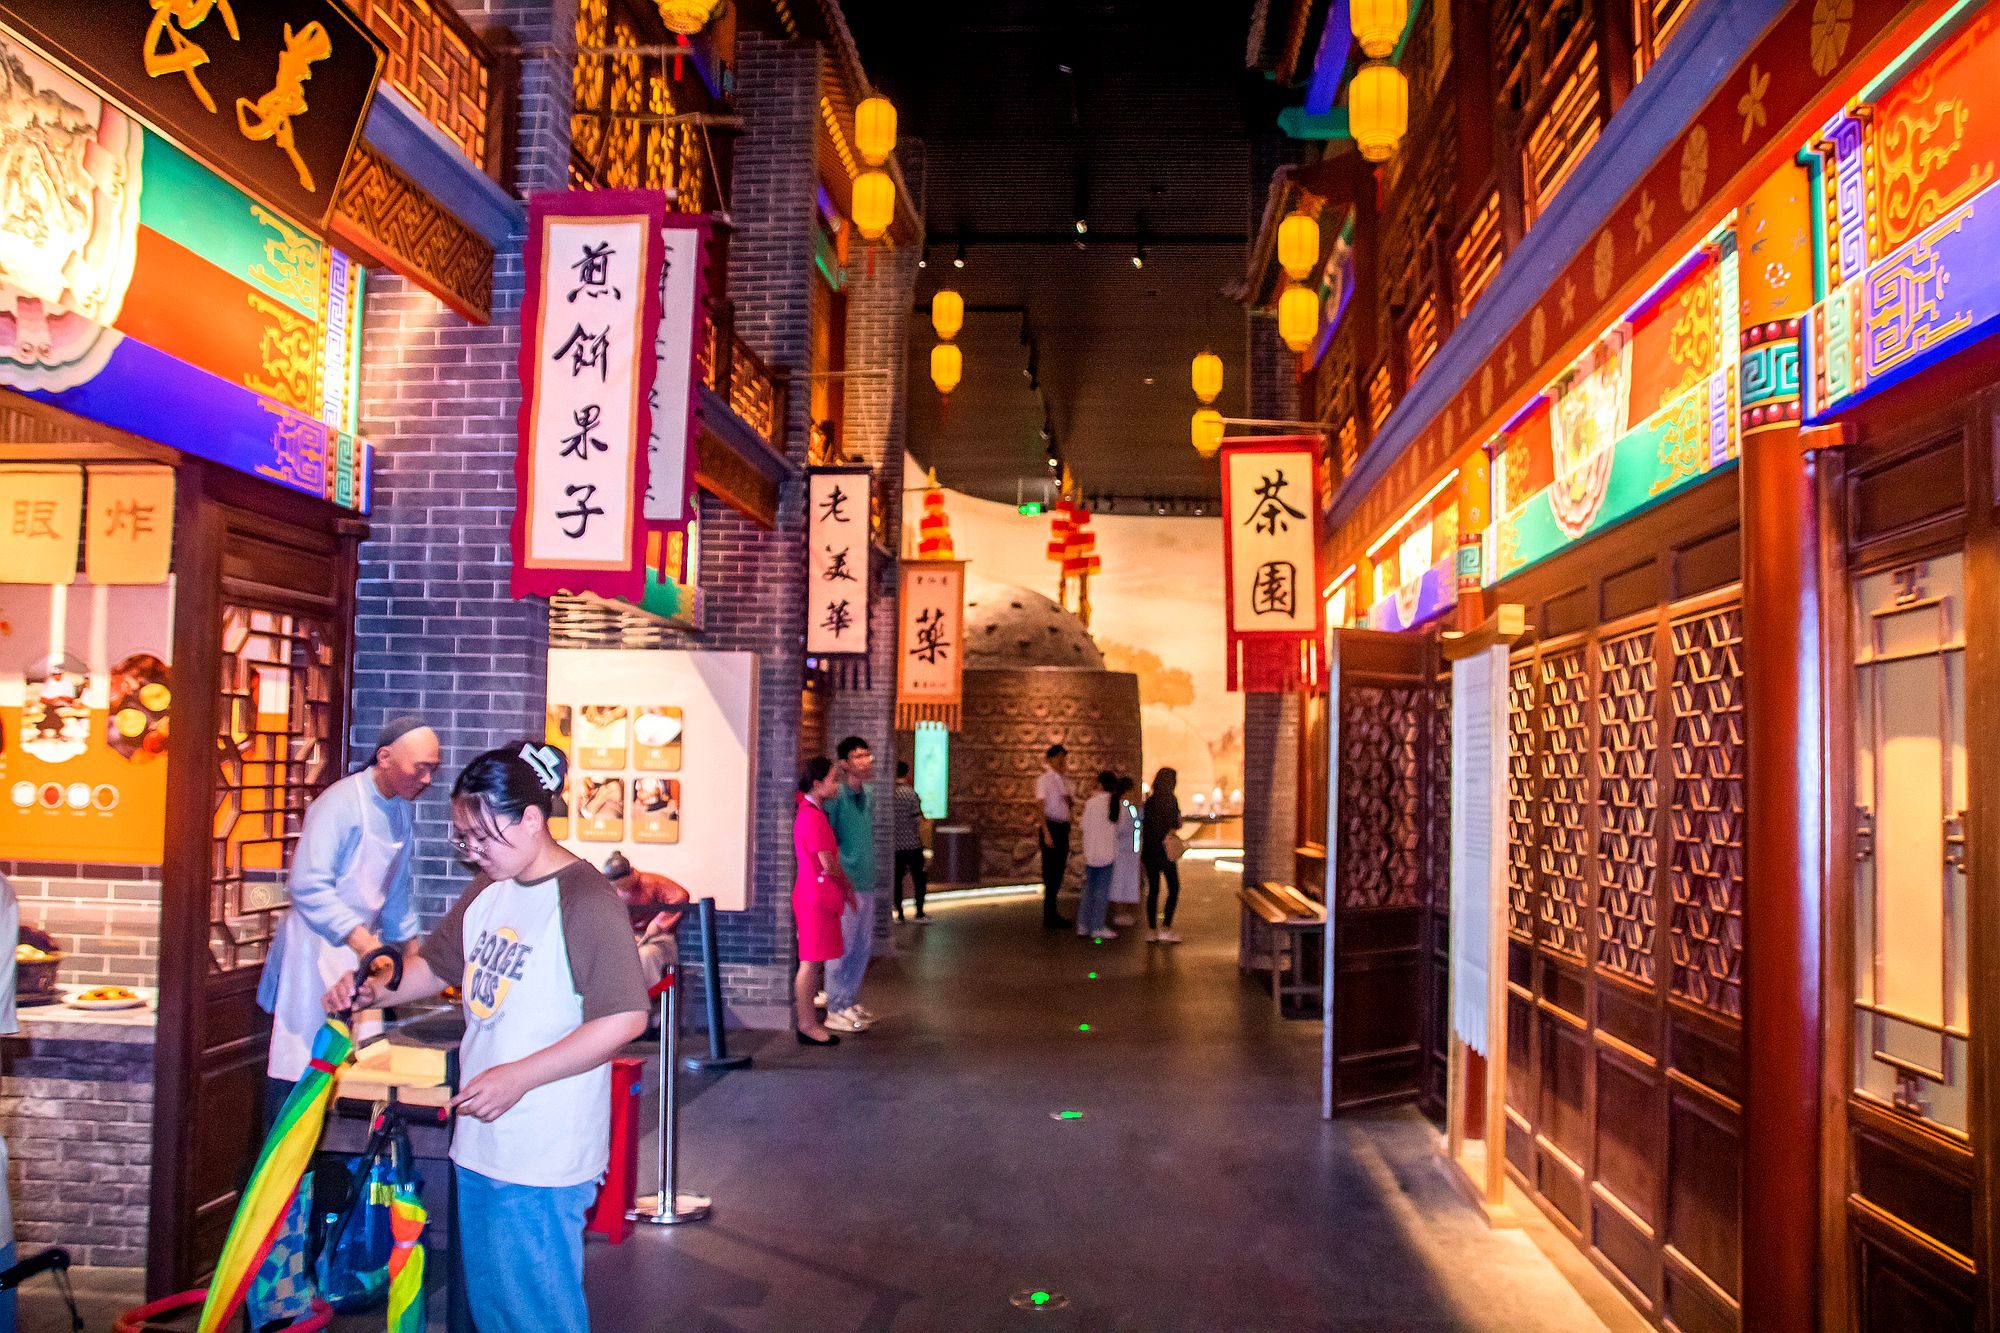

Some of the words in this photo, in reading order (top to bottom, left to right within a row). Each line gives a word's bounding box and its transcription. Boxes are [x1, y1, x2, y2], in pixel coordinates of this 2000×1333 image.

[552, 240, 622, 539] 煎餅果子
[819, 485, 857, 639] 老美華
[1243, 468, 1306, 619] 茶園
